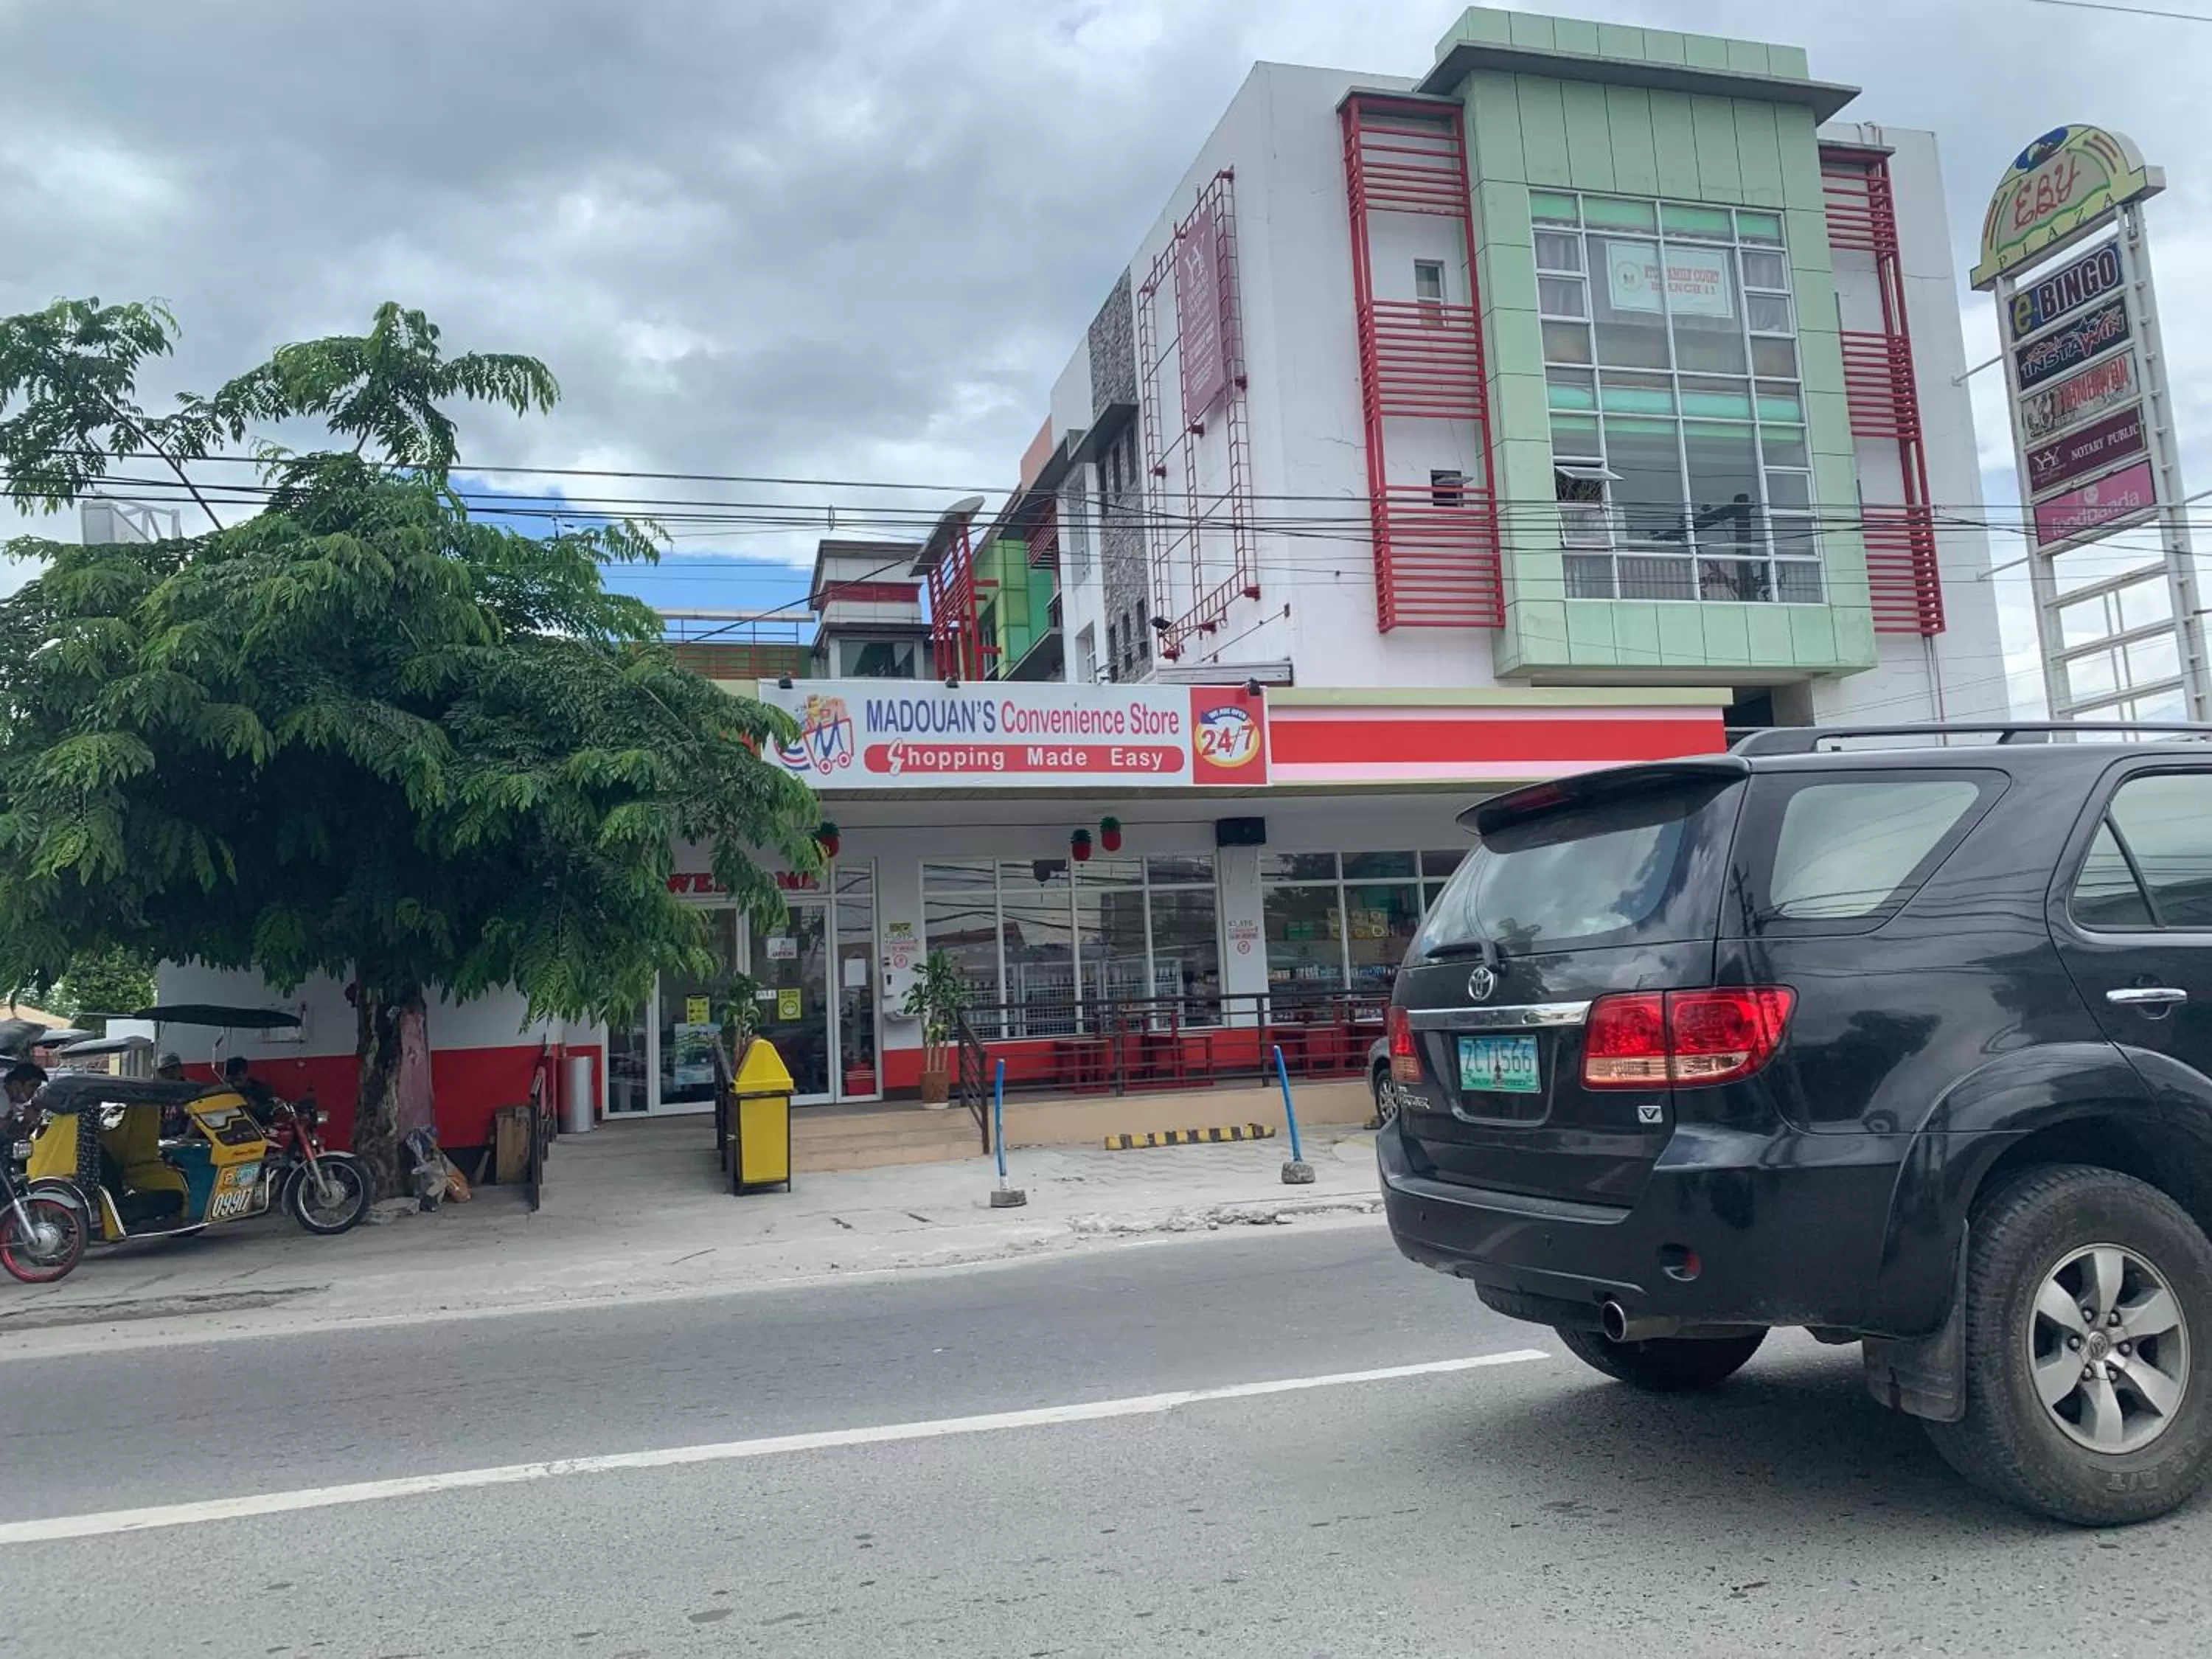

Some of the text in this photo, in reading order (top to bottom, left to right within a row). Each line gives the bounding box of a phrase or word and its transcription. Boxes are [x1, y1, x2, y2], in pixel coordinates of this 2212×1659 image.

[1997, 192, 2115, 271] PLAZA
[2037, 247, 2118, 322] BINGO
[2070, 437, 2105, 461] NOTARY
[2107, 422, 2140, 447] PUBLIC
[866, 699, 1180, 735] MADOUAN'S Convenience Store
[887, 737, 1163, 776] Shopping Made Easy
[1200, 725, 1255, 759] 24/7
[667, 870, 821, 894] WELME
[212, 1189, 253, 1218] 09917
